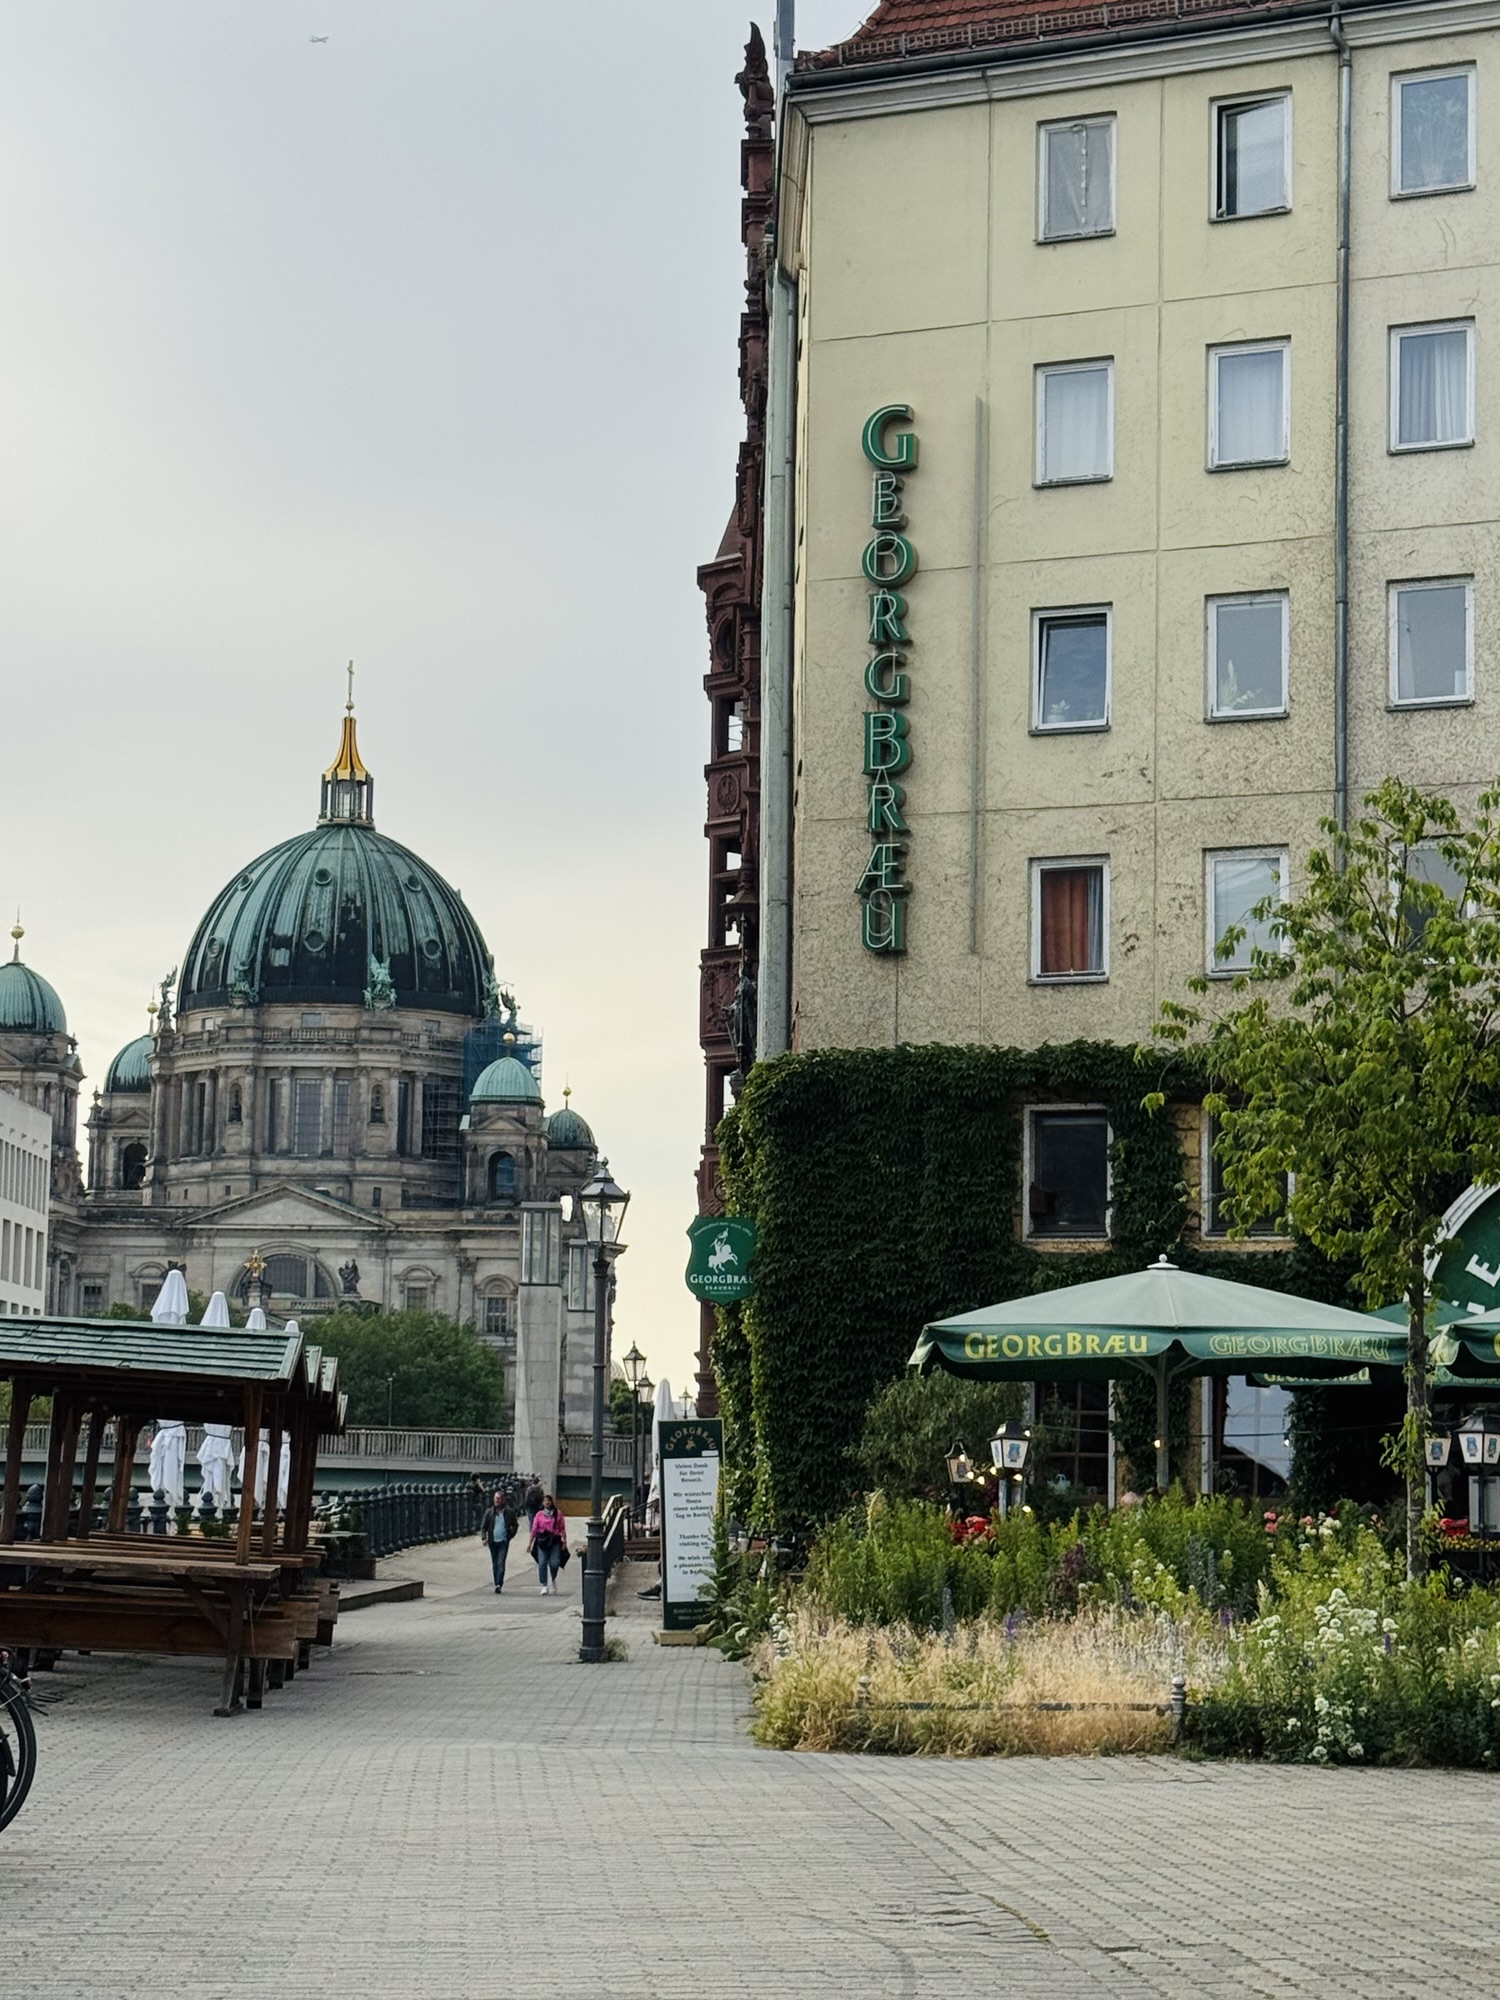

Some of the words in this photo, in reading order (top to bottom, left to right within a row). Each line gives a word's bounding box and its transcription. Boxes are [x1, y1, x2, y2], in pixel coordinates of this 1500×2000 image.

[857, 404, 919, 953] GEORGBRÆU
[964, 1332, 1148, 1359] GEORGBRÆU
[1209, 1334, 1390, 1361] GEORGBRÆU
